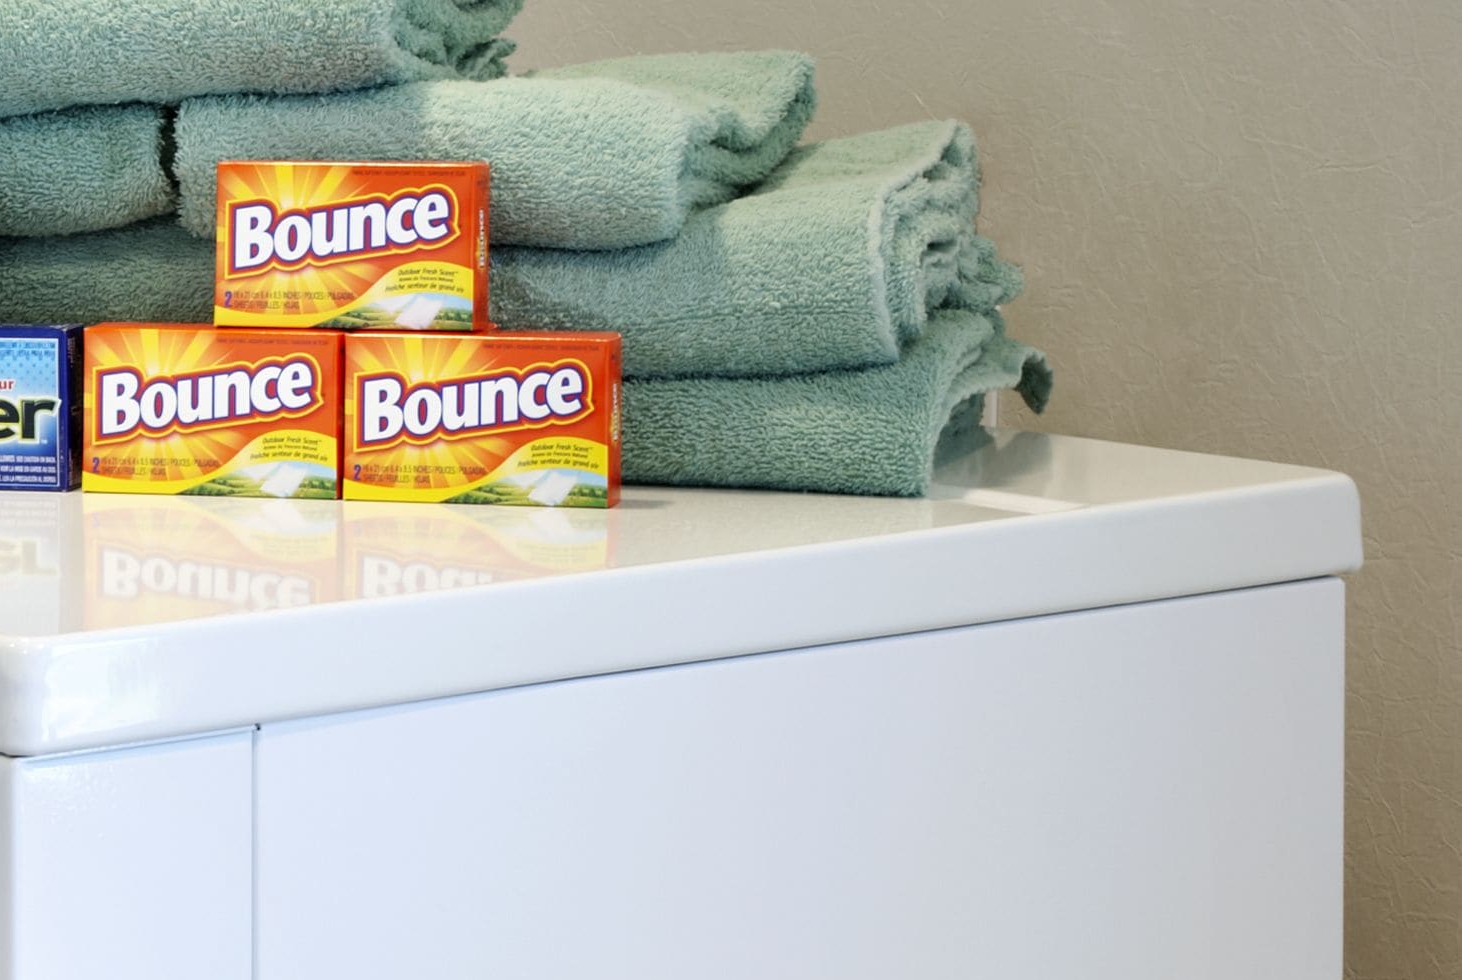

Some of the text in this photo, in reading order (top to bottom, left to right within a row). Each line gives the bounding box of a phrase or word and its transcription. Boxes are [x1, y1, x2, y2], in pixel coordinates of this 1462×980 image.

[234, 193, 449, 268] Bounce
[225, 291, 232, 307] 2
[101, 362, 313, 435] Bounce
[363, 368, 583, 442] Bounce
[92, 457, 100, 473] 2
[353, 464, 362, 481] 2
